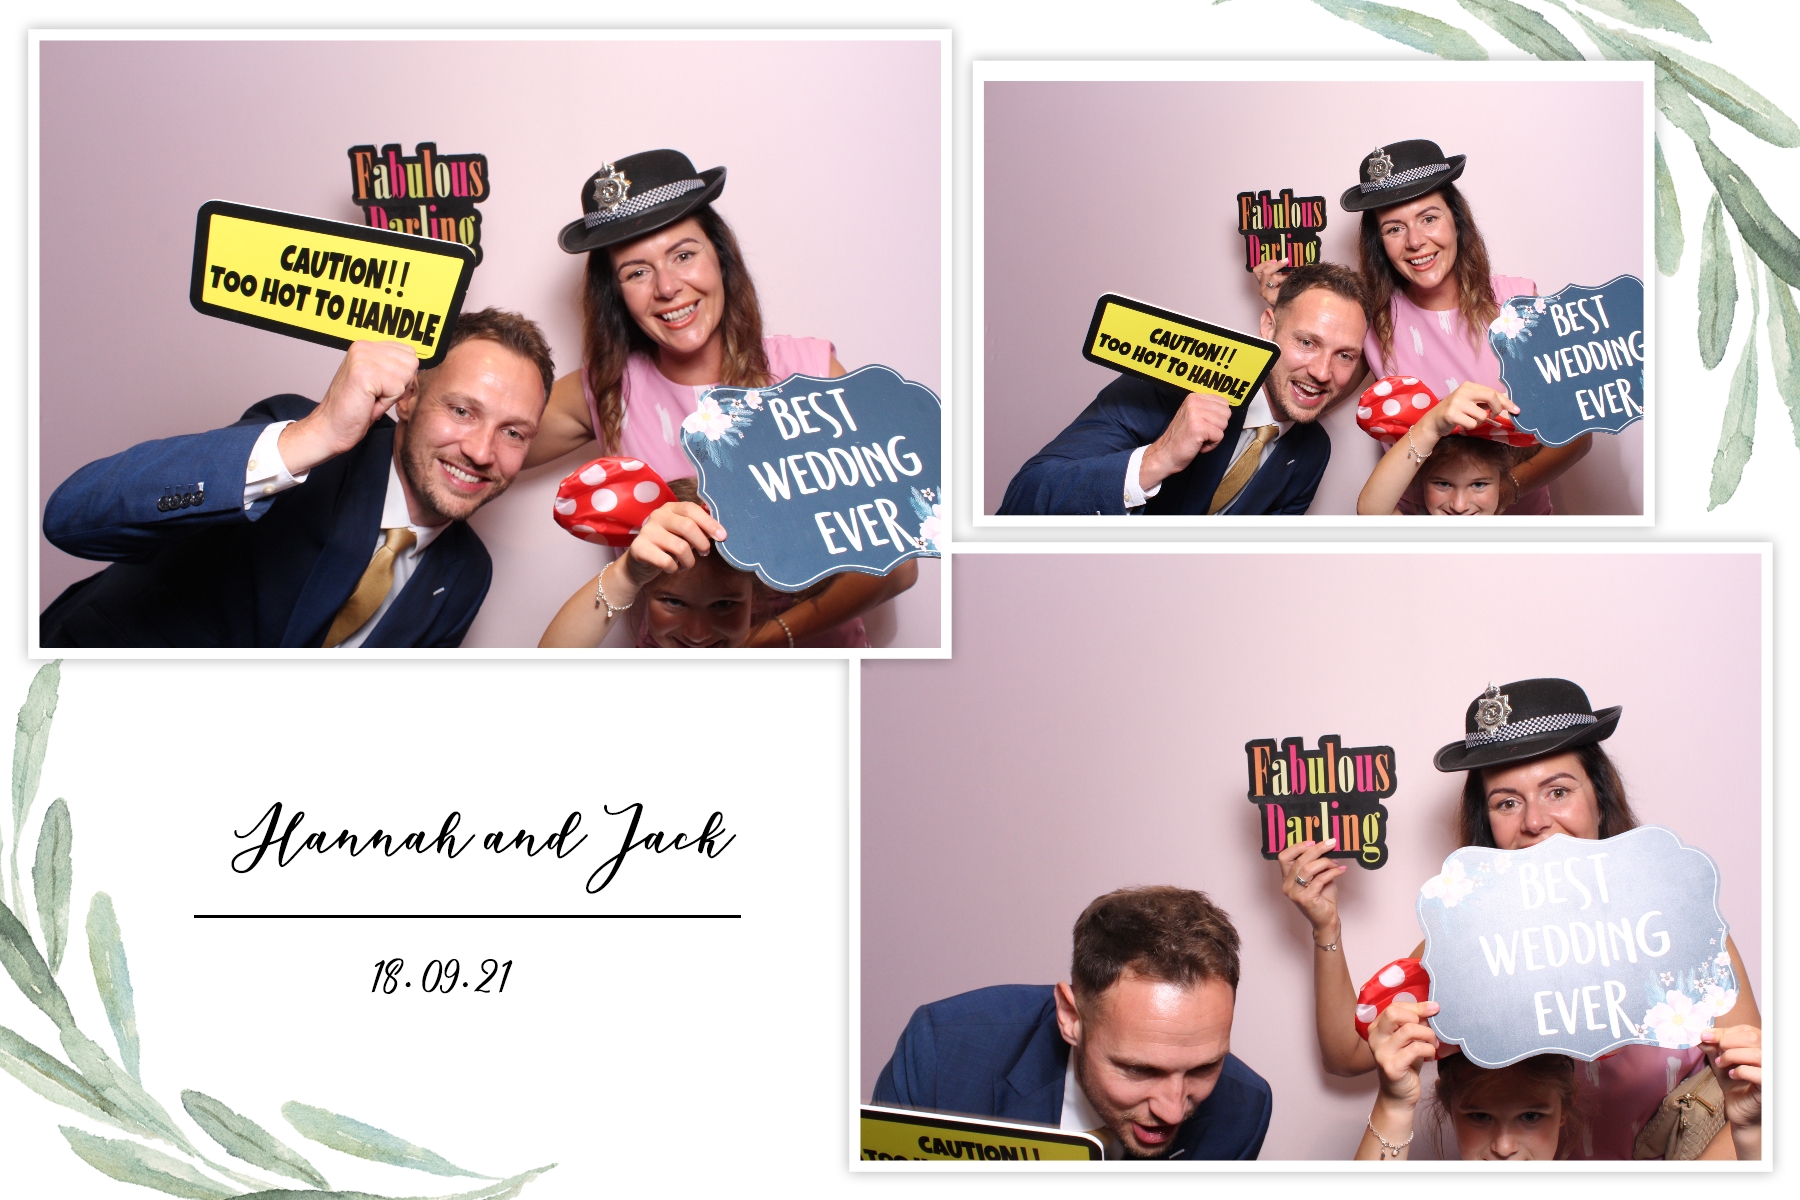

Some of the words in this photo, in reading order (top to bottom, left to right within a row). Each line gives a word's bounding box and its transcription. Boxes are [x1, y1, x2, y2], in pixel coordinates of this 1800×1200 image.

[353, 150, 484, 200] Fabulous
[1241, 193, 1323, 231] Fabulous
[280, 244, 411, 298] CAUTION!!
[1248, 233, 1317, 268] Darling
[210, 264, 258, 298] TOO
[260, 277, 312, 312] HOT
[315, 288, 345, 321] TO
[346, 297, 441, 347] HANDLE
[1550, 294, 1610, 337] BEST
[1099, 333, 1132, 356] TOO
[1131, 345, 1168, 369] HOT
[1166, 357, 1189, 377] TO
[1186, 365, 1250, 400] HANDLE
[1149, 328, 1238, 369] CAUTION!!
[1533, 330, 1644, 384] WEDDING
[769, 388, 858, 440] BEST
[1575, 378, 1643, 421] EVER
[748, 435, 923, 502] WEDDING
[815, 498, 922, 555] EVER
[1252, 742, 1391, 797] Fabulous
[1265, 801, 1381, 863] Darling
[1518, 853, 1610, 911] BEST
[1478, 910, 1671, 977] WEDDING
[1533, 980, 1637, 1039] EVER
